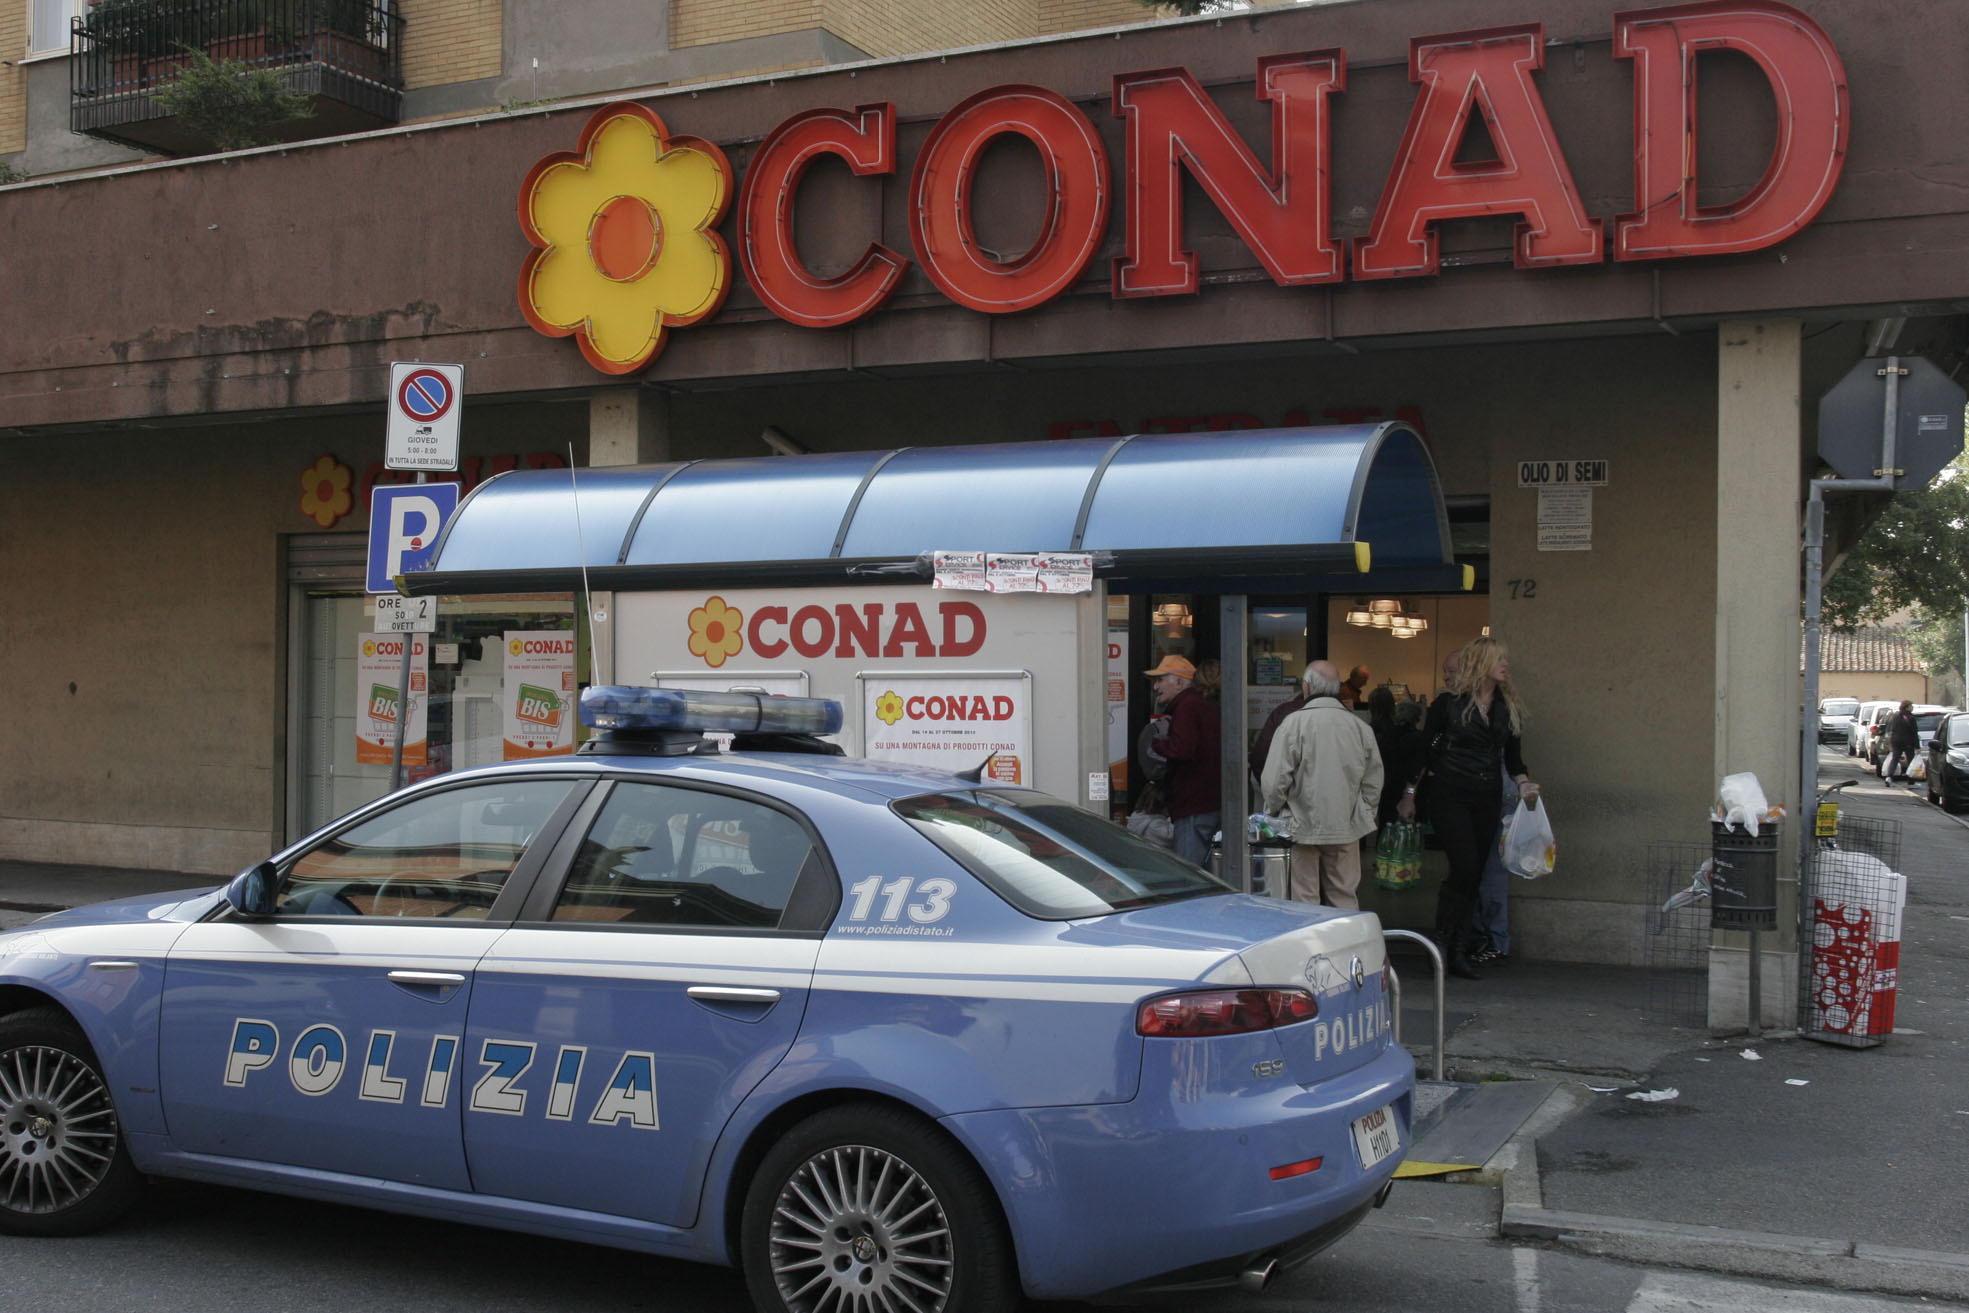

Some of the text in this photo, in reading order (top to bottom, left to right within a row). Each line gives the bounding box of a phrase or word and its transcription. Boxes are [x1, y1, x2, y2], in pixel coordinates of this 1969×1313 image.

[737, 0, 1850, 328] CONAD
[407, 436, 439, 444] GIOVEDI
[430, 458, 454, 466] STRADALE
[1521, 461, 1606, 483] OLIO DI SEMI
[386, 495, 441, 580] P
[1047, 557, 1080, 566] SPORT
[1508, 579, 1536, 600] 72
[378, 598, 428, 619] ORE 2
[748, 601, 987, 659] CONAD
[376, 642, 424, 655] COND
[521, 697, 551, 720] BIS
[906, 695, 1015, 721] CONAD
[875, 742, 884, 750] SU
[886, 742, 900, 750] UNA
[902, 742, 941, 750] MONTAGNA
[953, 743, 988, 751] PRODOTTI
[990, 743, 1016, 751] CONAD
[850, 875, 957, 924] 113
[838, 925, 955, 937] www.poliziadistato.it
[223, 1017, 660, 1131] POLIZIA
[1252, 1059, 1284, 1079] 159
[1362, 1109, 1386, 1134] POLIZIA
[1370, 1130, 1392, 1161] H1101
